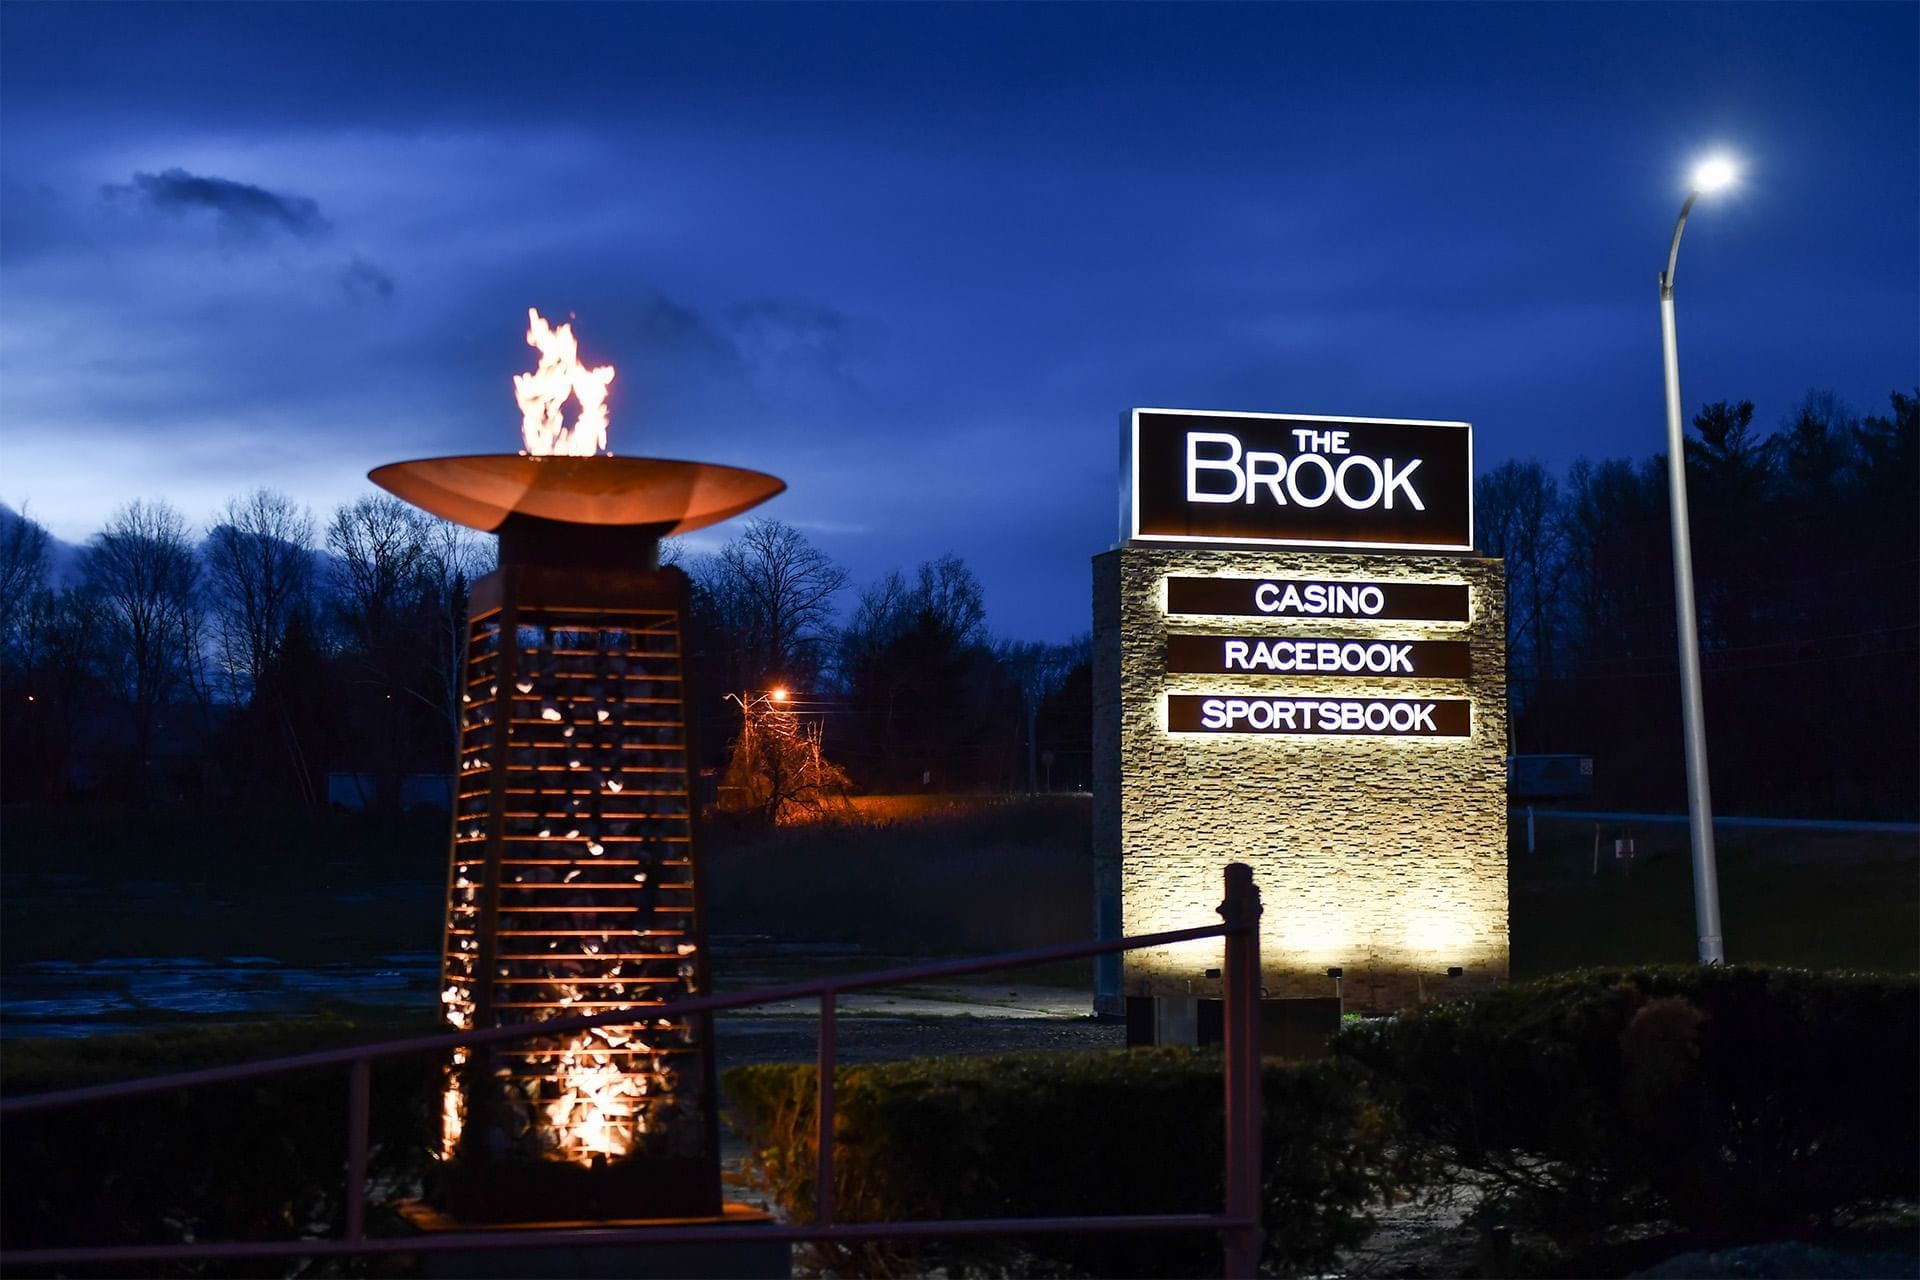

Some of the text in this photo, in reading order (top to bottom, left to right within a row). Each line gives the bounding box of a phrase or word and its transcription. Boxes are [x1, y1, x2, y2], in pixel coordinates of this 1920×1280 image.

[1292, 429, 1351, 454] THE
[1186, 431, 1426, 511] BROOK
[1255, 583, 1385, 615] CASINO
[1225, 640, 1414, 673] RACEBOOK
[1201, 699, 1437, 732] SPORTSBOOK
